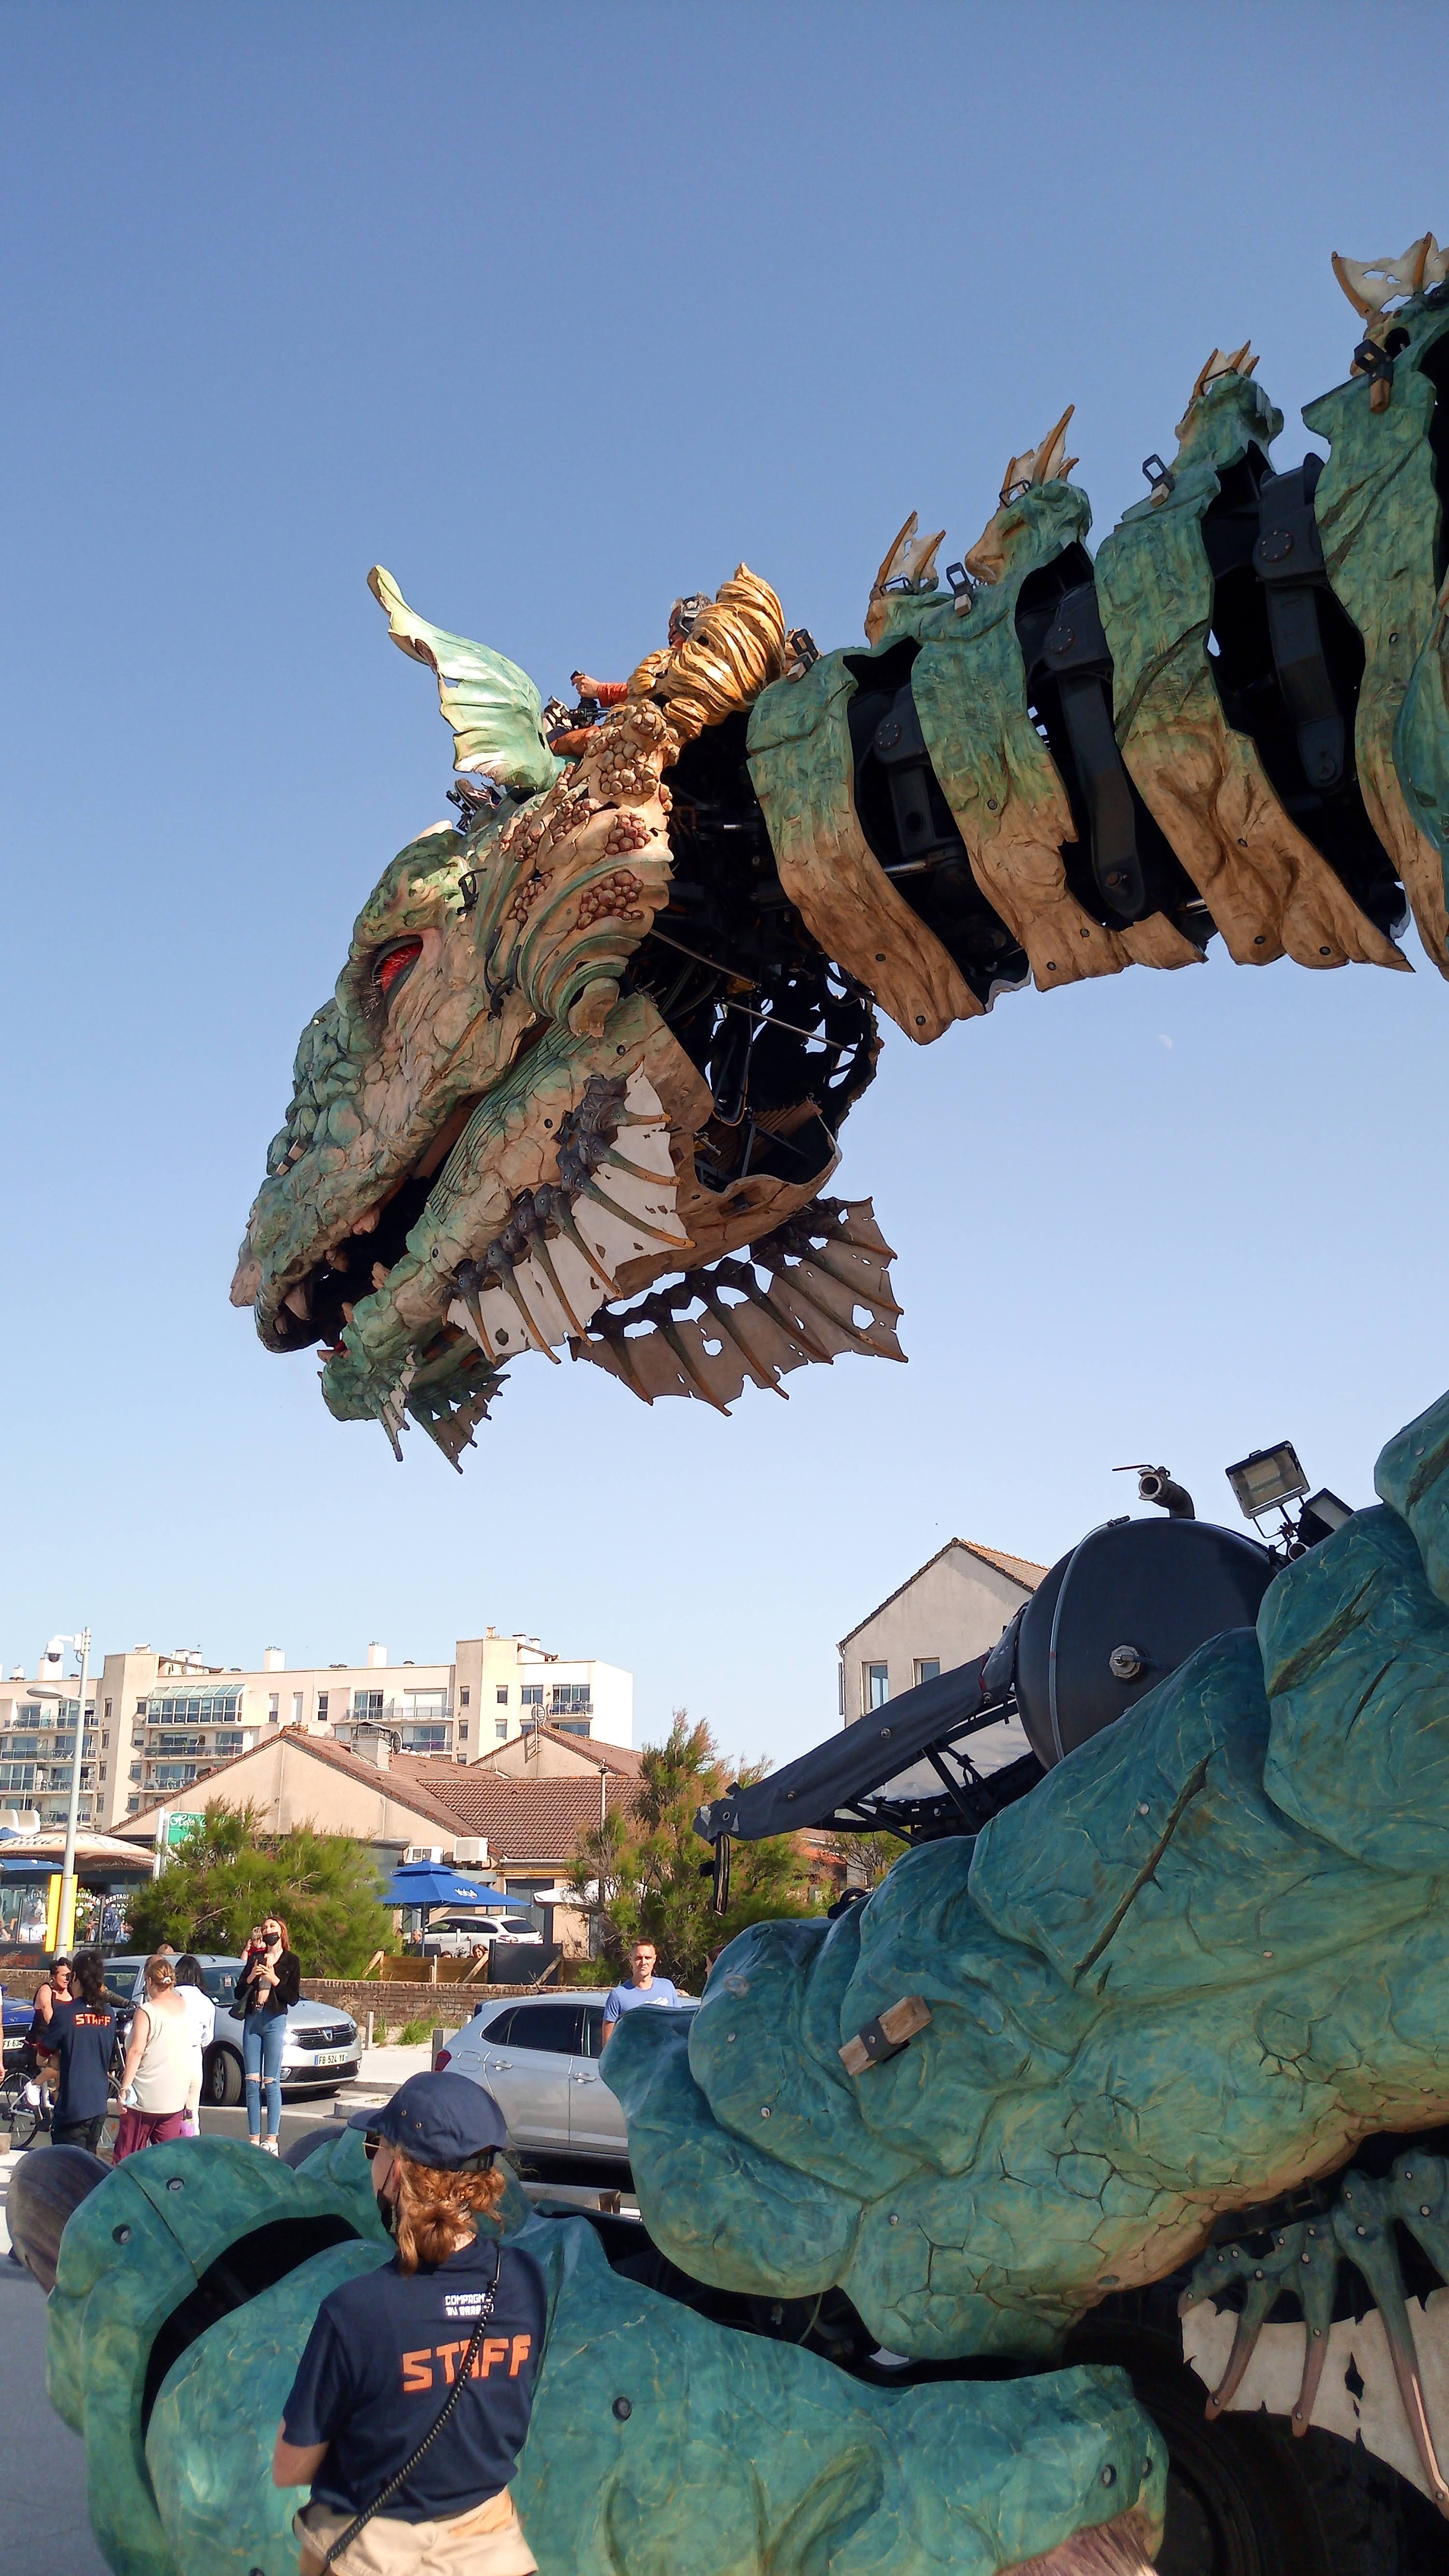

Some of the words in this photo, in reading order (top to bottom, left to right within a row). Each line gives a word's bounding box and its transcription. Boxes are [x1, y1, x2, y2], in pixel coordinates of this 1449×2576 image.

[455, 1888, 478, 1897] 1664
[445, 2292, 492, 2306] COMPAGN
[402, 2334, 531, 2391] STAFF
